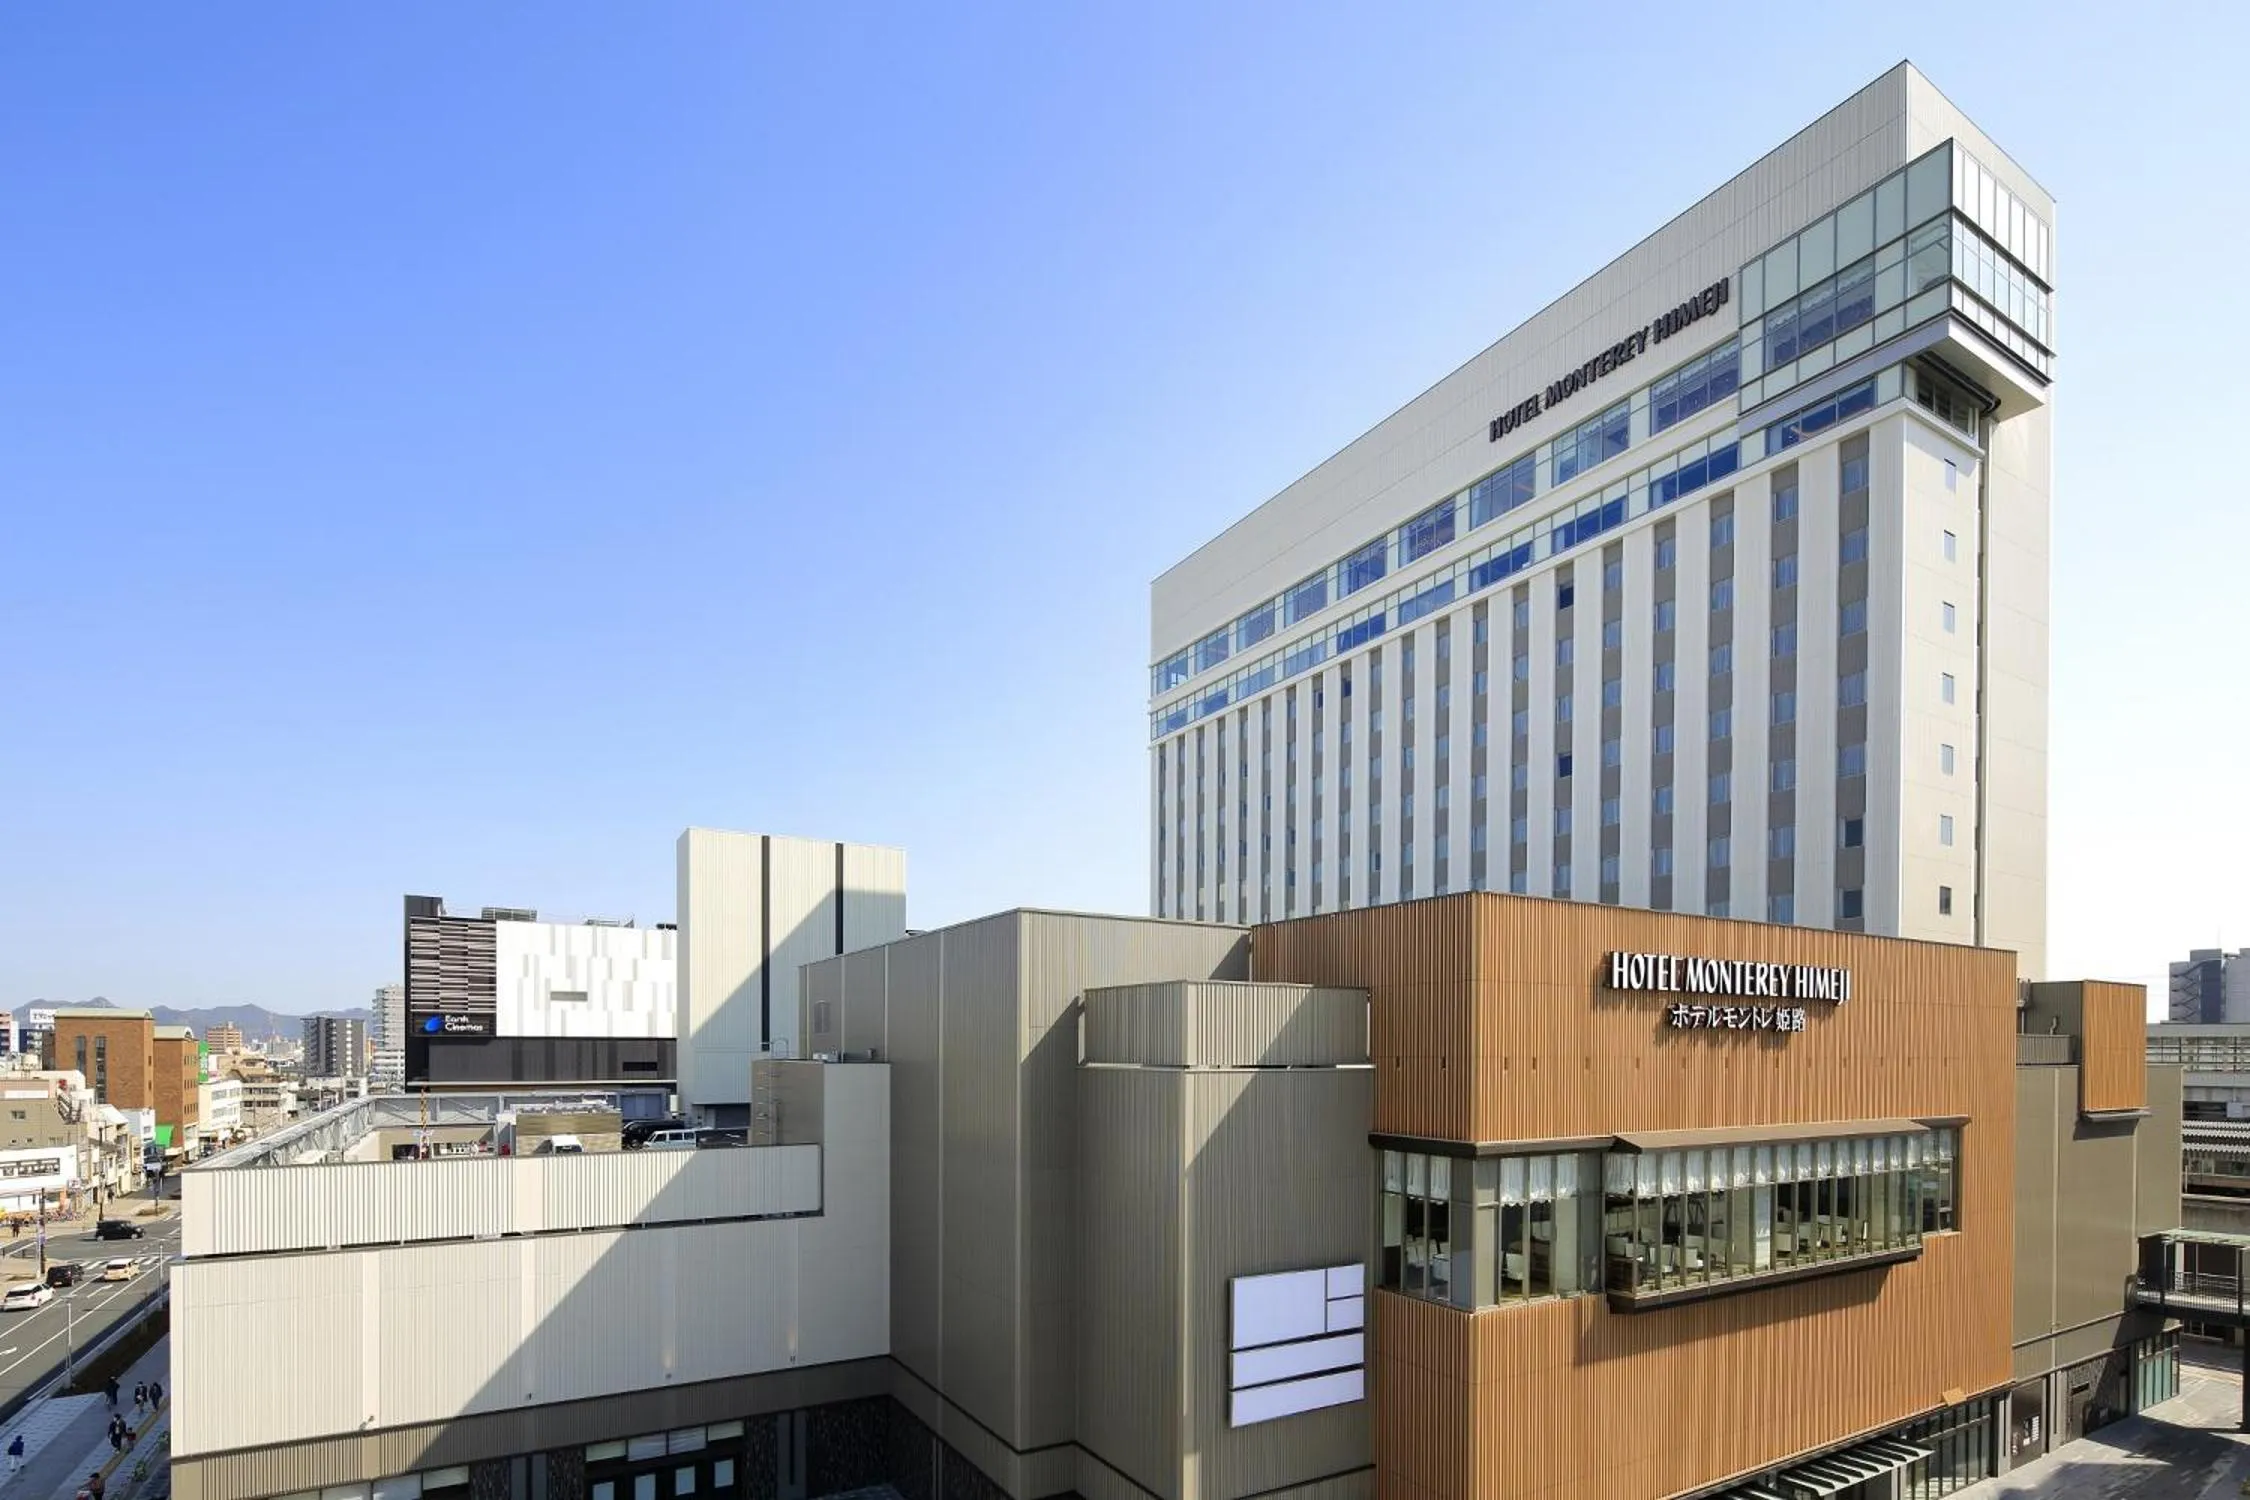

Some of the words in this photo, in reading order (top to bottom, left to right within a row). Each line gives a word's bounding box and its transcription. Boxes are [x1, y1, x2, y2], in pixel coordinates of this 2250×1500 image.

[1489, 394, 1542, 442] HOTEL
[1544, 326, 1650, 410] MONTEREY
[1653, 277, 1729, 344] HIMEJI
[1612, 951, 1681, 991] HOTEL
[1685, 957, 1791, 996] MONTEREY
[1795, 964, 1851, 1006] HIMEJI
